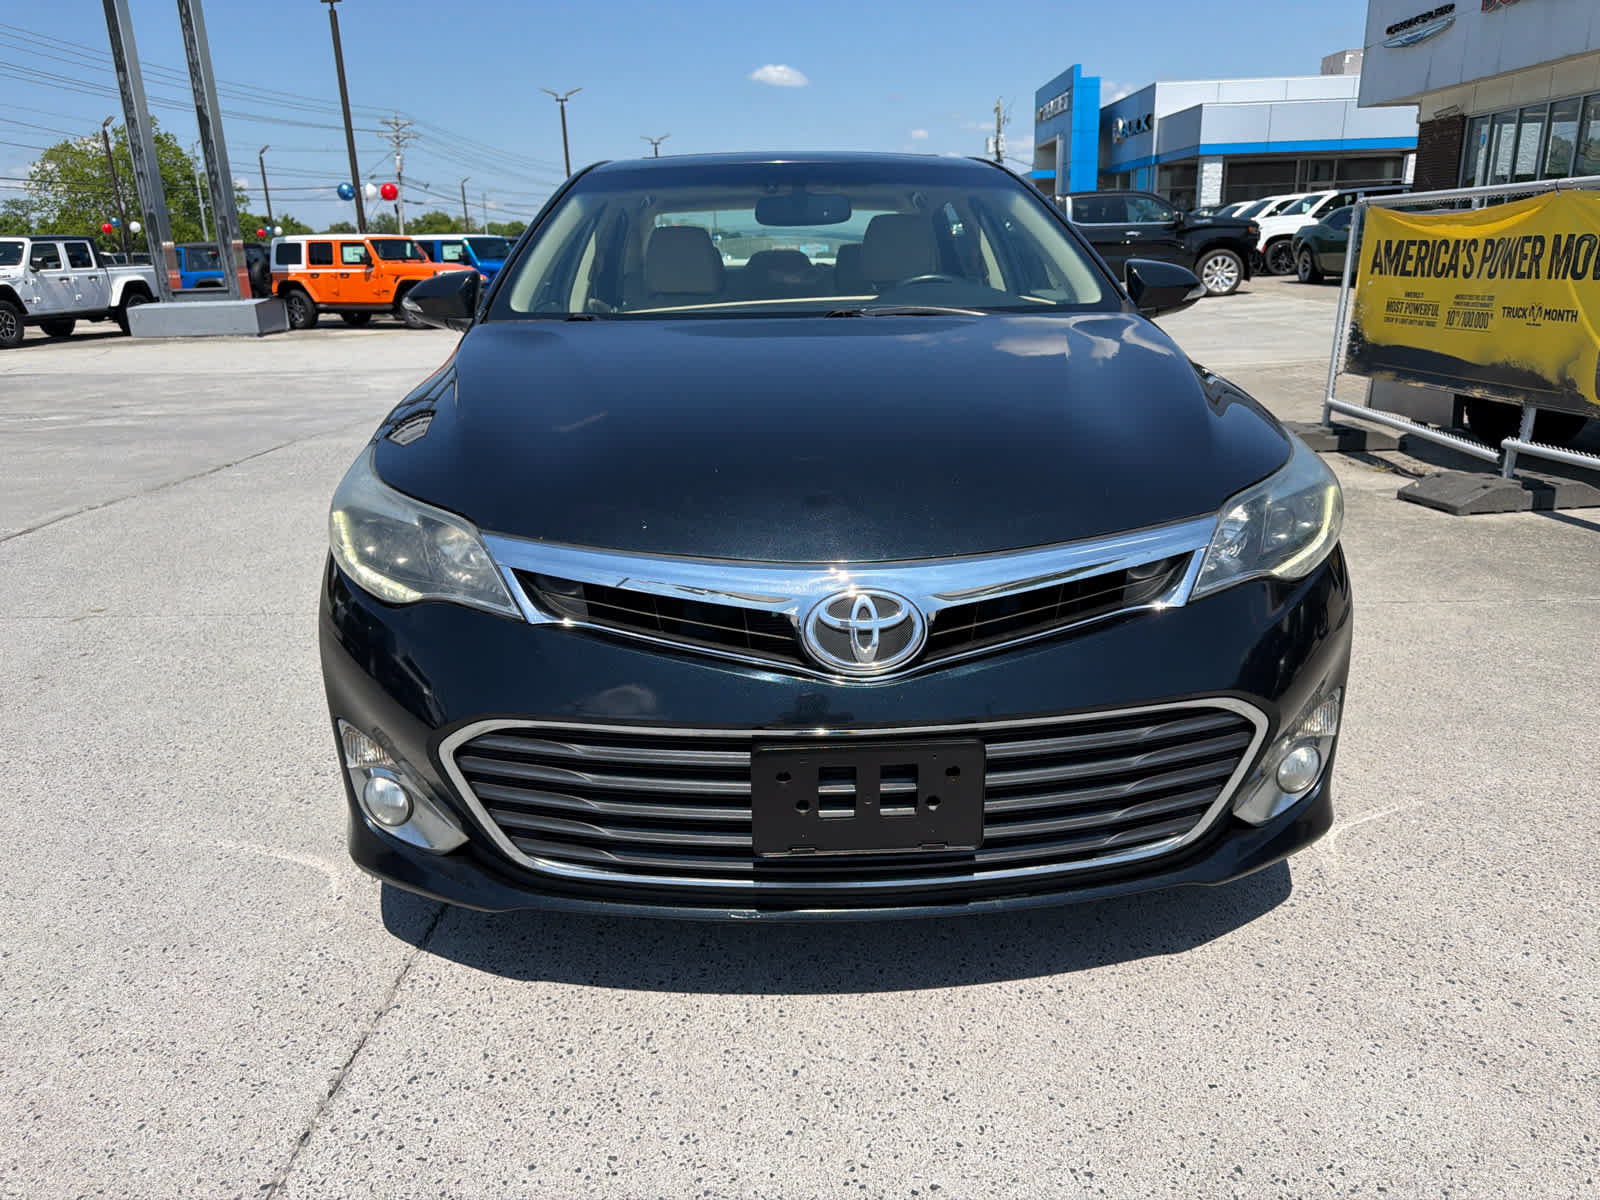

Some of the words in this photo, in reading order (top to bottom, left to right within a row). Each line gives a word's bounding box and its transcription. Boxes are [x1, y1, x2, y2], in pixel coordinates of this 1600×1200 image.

[1370, 238, 1479, 279] AMERICA'S
[1477, 234, 1546, 280] POWER
[1386, 300, 1405, 314] MOST
[1404, 302, 1440, 317] POWERFUL
[1502, 306, 1529, 320] TRUCK
[1543, 308, 1579, 323] MONTH
